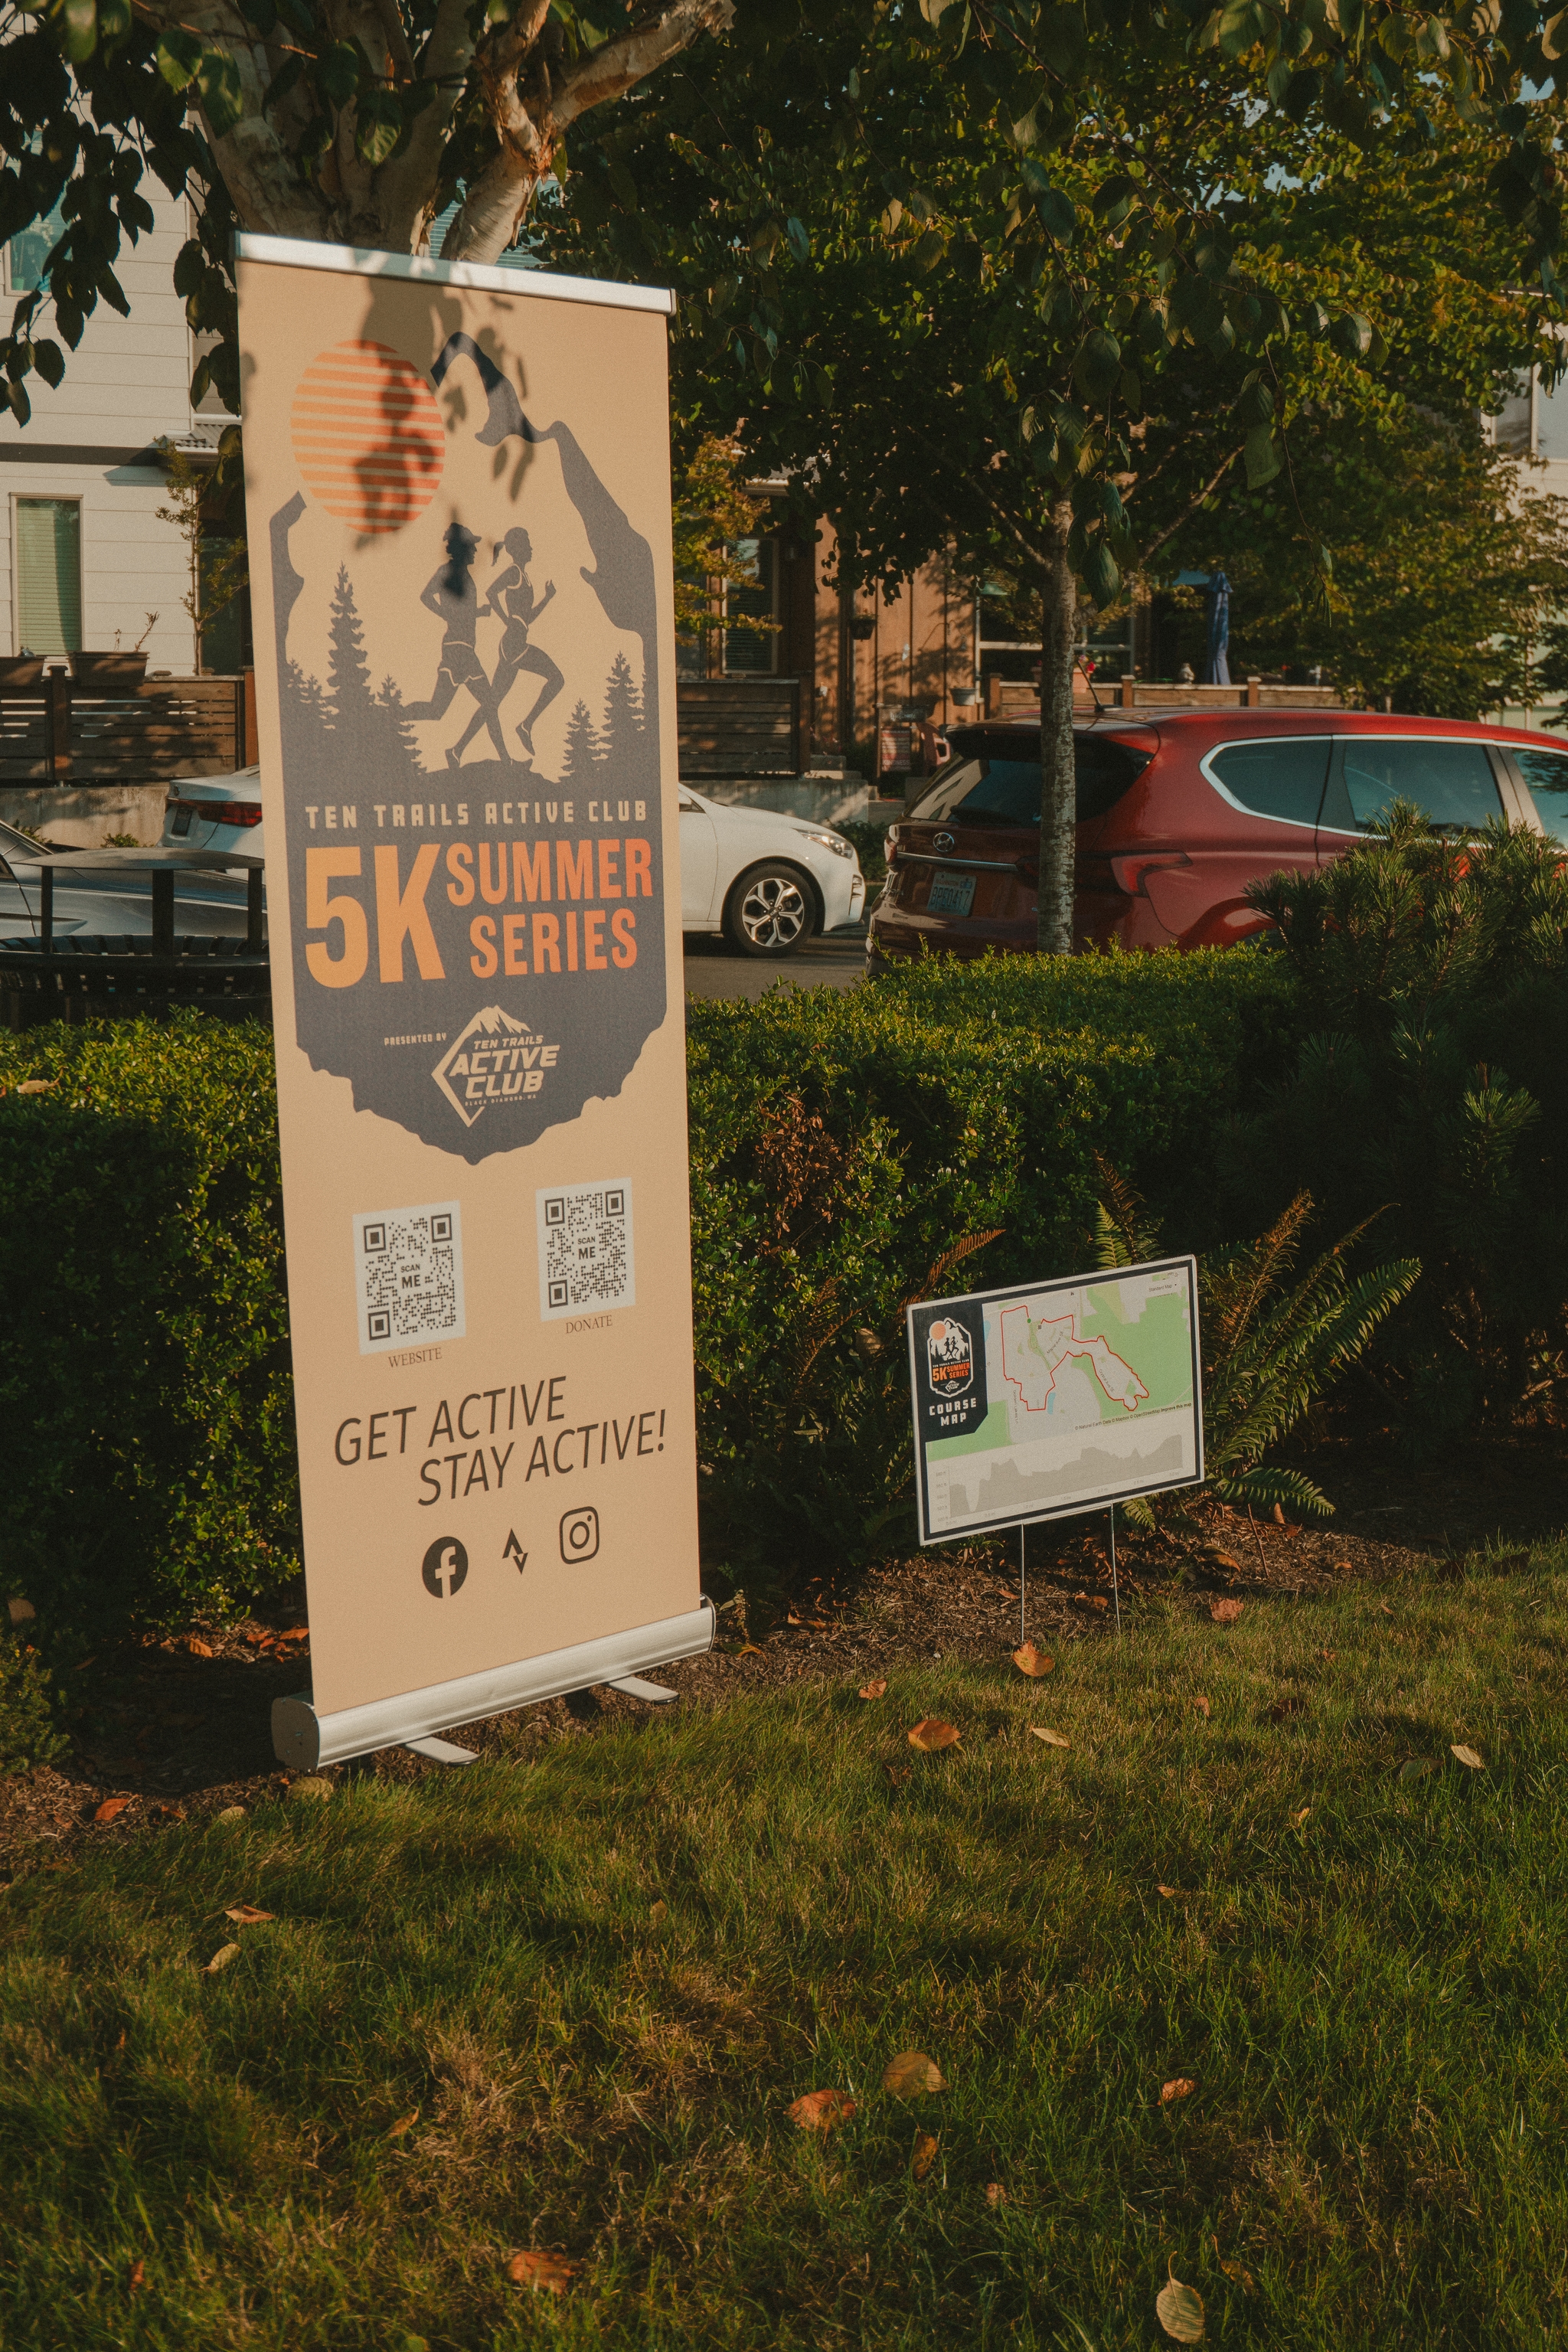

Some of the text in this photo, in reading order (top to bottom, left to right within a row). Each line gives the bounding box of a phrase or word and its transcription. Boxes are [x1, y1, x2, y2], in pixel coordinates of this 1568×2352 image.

[305, 800, 646, 829] TEN TRAILS ACTIVE CLUB
[305, 838, 653, 988] 5K SUMMER
[469, 908, 637, 978] SERIES
[384, 1032, 447, 1046] PRESENTED BY
[474, 1035, 544, 1050] TEN TRAILS
[449, 1044, 560, 1076] ACTIVE
[466, 1070, 544, 1099] CLUB
[577, 1236, 596, 1245] SCAN
[578, 1246, 596, 1260] ME
[400, 1263, 420, 1273] SCAN
[401, 1275, 421, 1289] ME
[565, 1315, 613, 1334] DONATE
[388, 1348, 443, 1368] WEBSITE
[933, 1362, 970, 1381] 5K SUMMER
[949, 1370, 969, 1379] SERIES
[929, 1397, 977, 1416] COURSE
[335, 1376, 567, 1466] GET ACTIVE
[940, 1412, 966, 1426] MAP
[417, 1409, 665, 1506] STAY ACTIVE!
